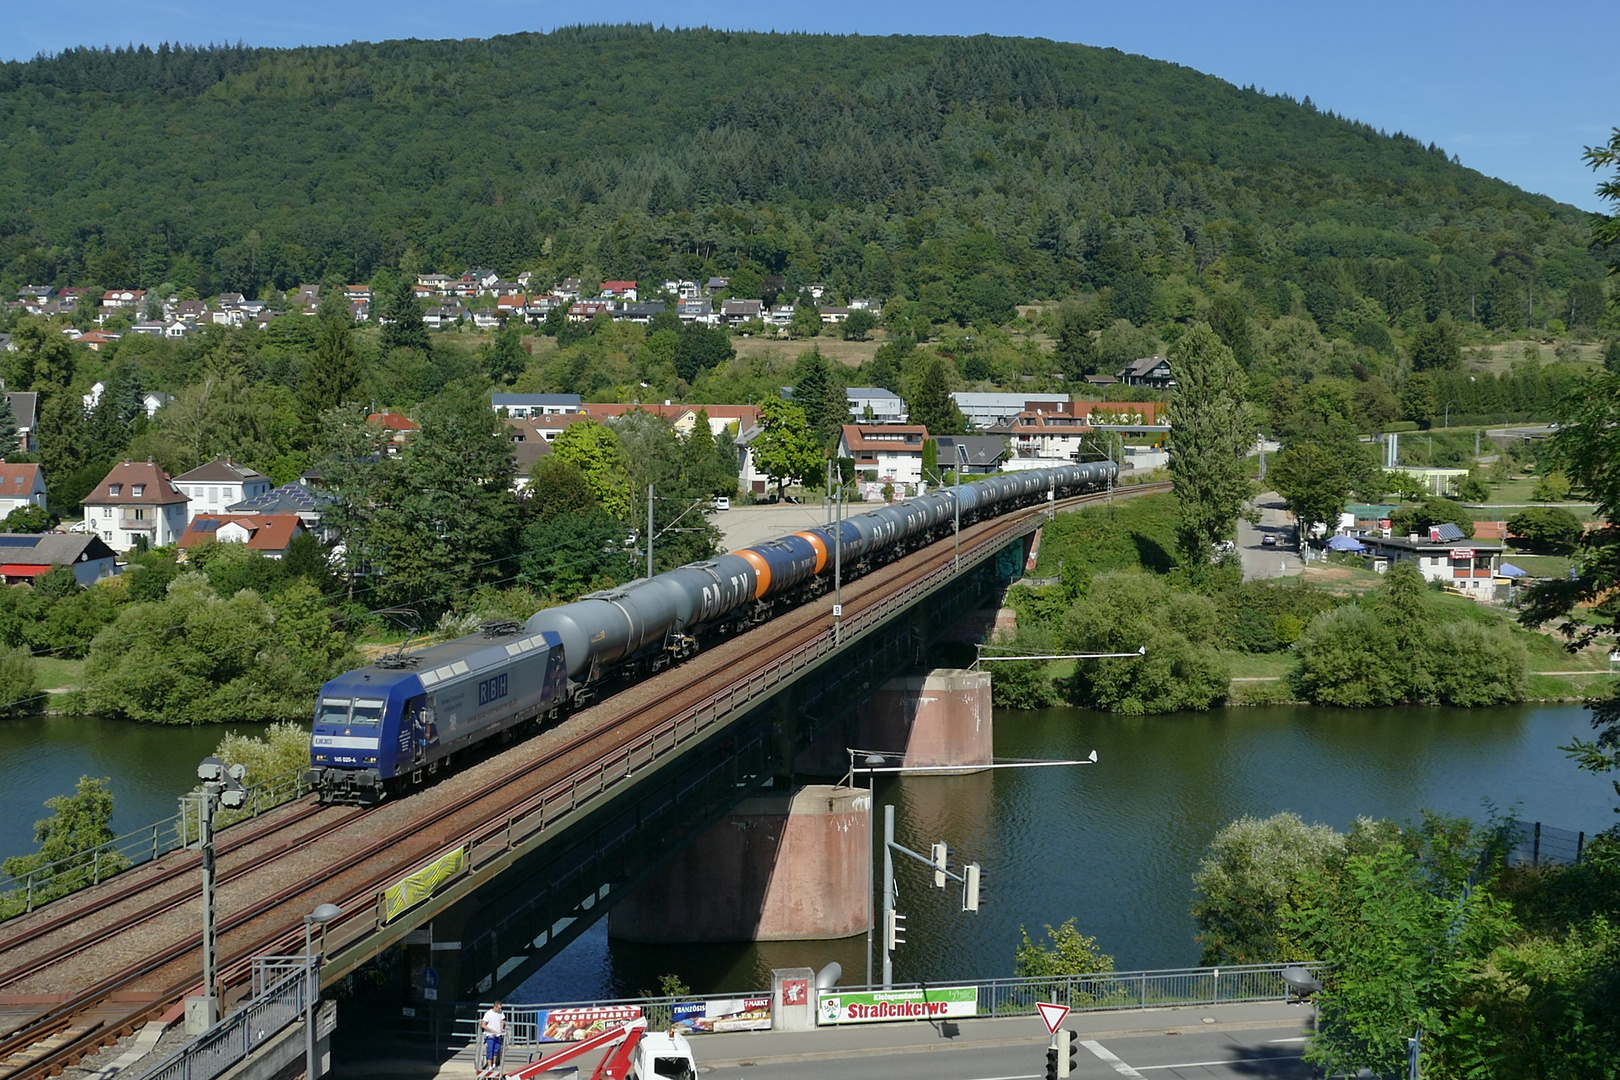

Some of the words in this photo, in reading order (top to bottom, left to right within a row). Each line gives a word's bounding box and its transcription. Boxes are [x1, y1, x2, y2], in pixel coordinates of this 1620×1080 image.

[835, 606, 840, 615] 9
[479, 674, 507, 705] RBH
[554, 1011, 636, 1022] WOCHENMARKT
[847, 1000, 948, 1019] Straßenkerwe
